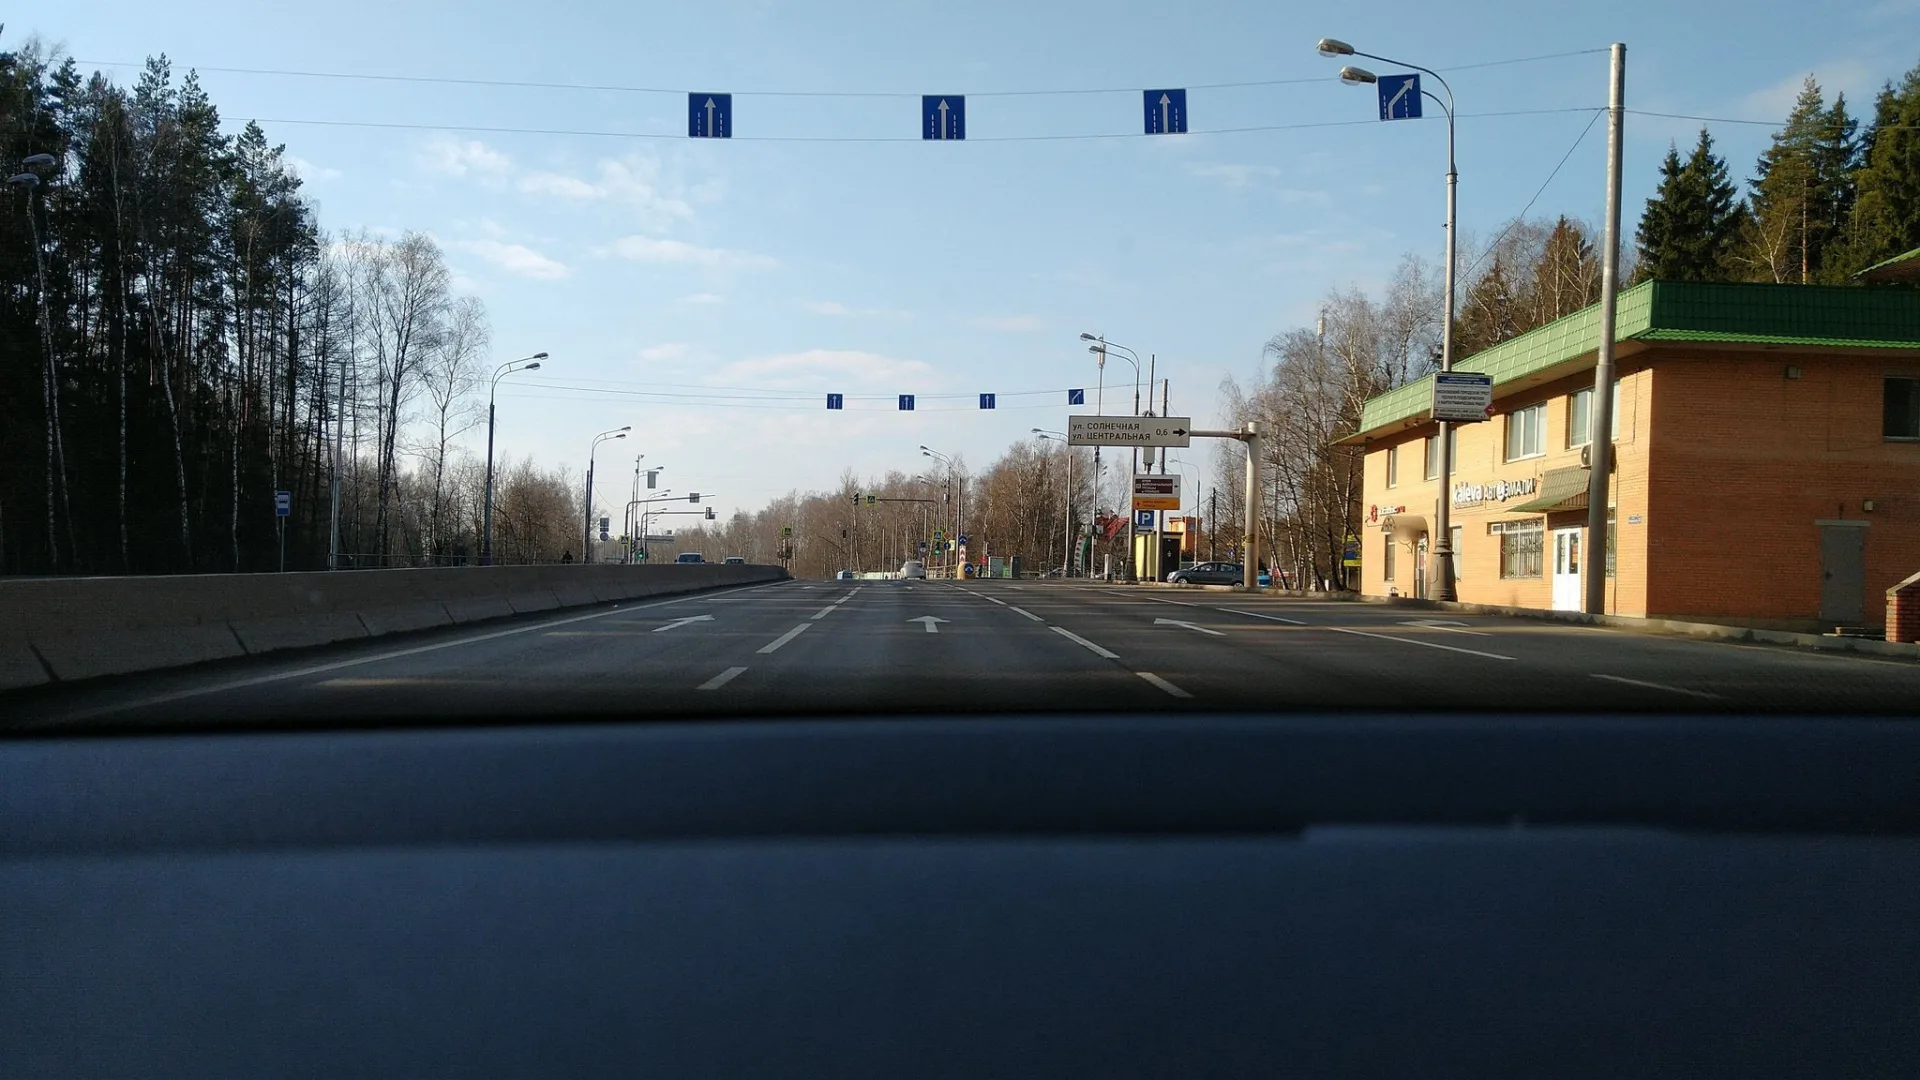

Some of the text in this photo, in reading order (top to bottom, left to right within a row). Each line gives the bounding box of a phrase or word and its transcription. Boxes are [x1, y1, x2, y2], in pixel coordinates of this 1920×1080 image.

[1087, 423, 1140, 431] СОЛНЕЧНАЯ
[1086, 432, 1151, 441] ЦЕНТРАЛЬНАЯ
[1155, 428, 1168, 437] 0,6
[1454, 481, 1483, 503] kaleva
[1141, 512, 1151, 525] P
